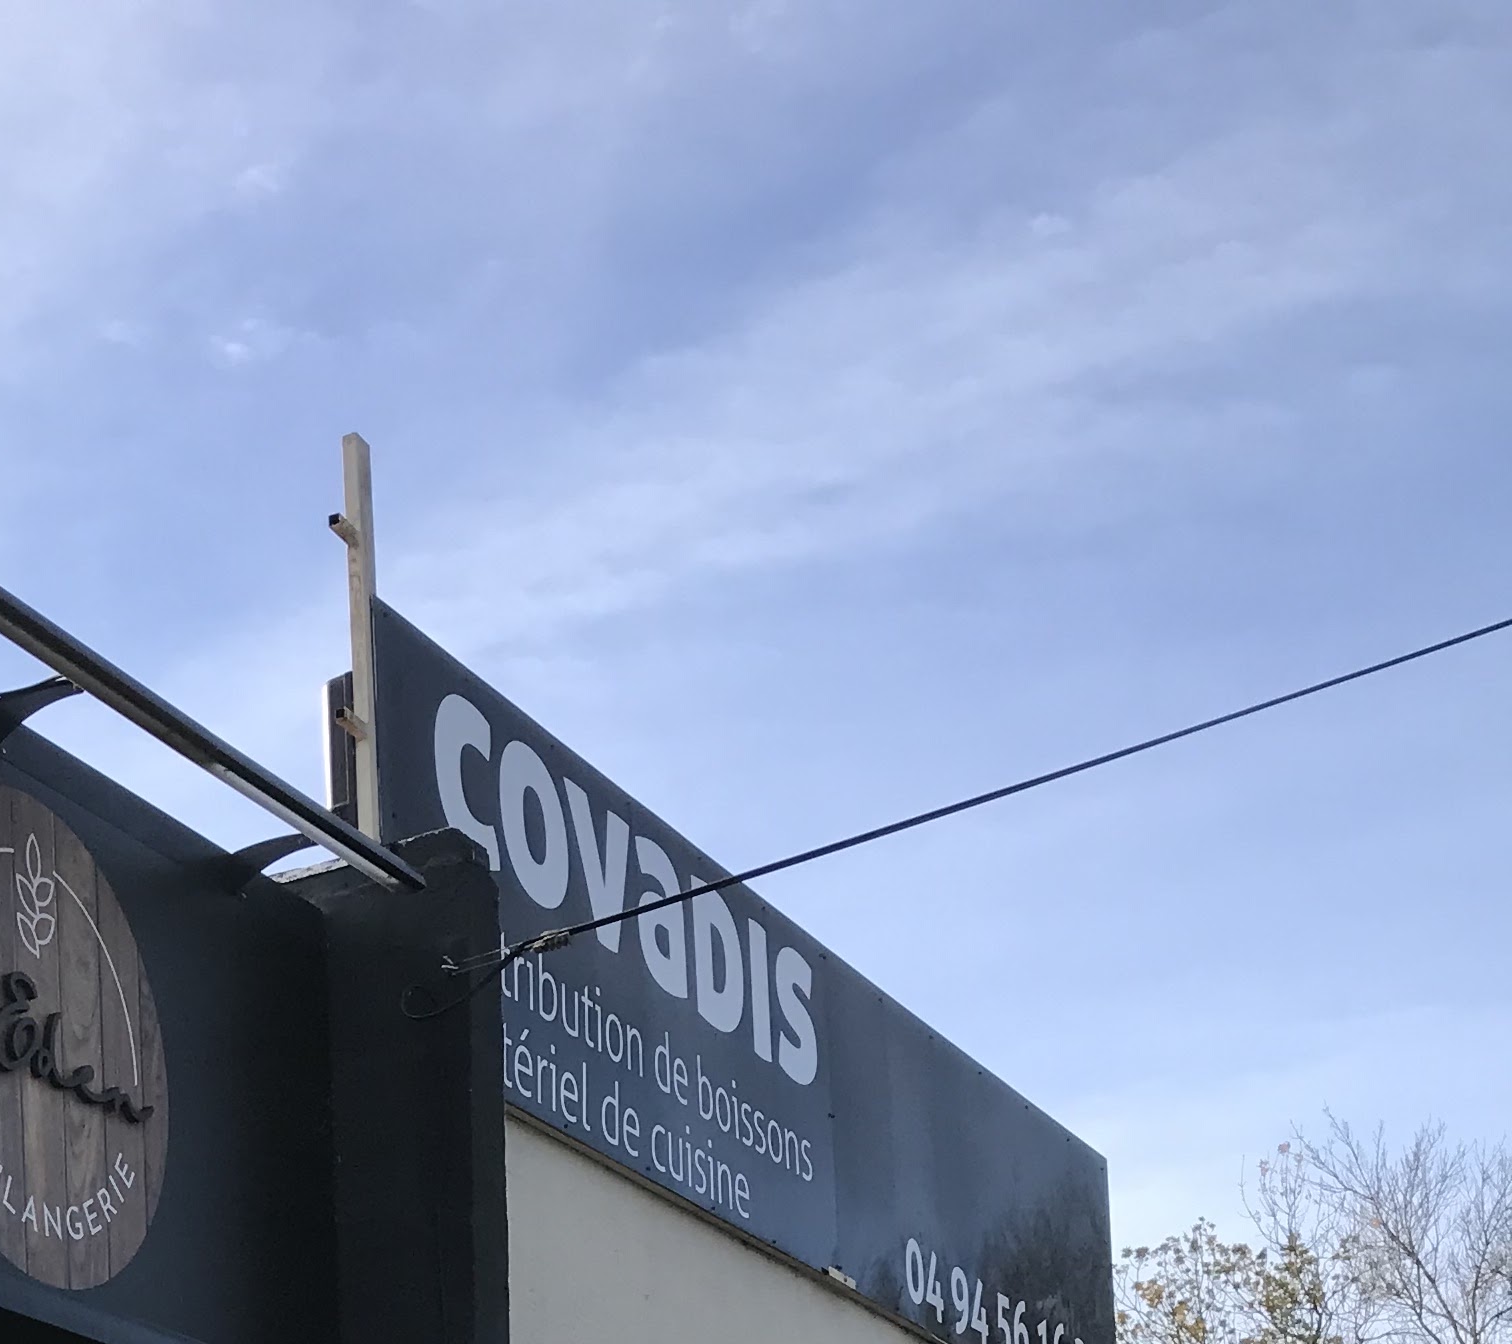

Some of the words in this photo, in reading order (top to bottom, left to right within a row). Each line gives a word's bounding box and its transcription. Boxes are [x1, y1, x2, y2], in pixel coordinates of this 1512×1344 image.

[601, 1081, 640, 1158] de
[651, 1124, 751, 1219] cuisine
[655, 1031, 688, 1105] de
[697, 1055, 813, 1182] boissons
[906, 1238, 943, 1323] 04
